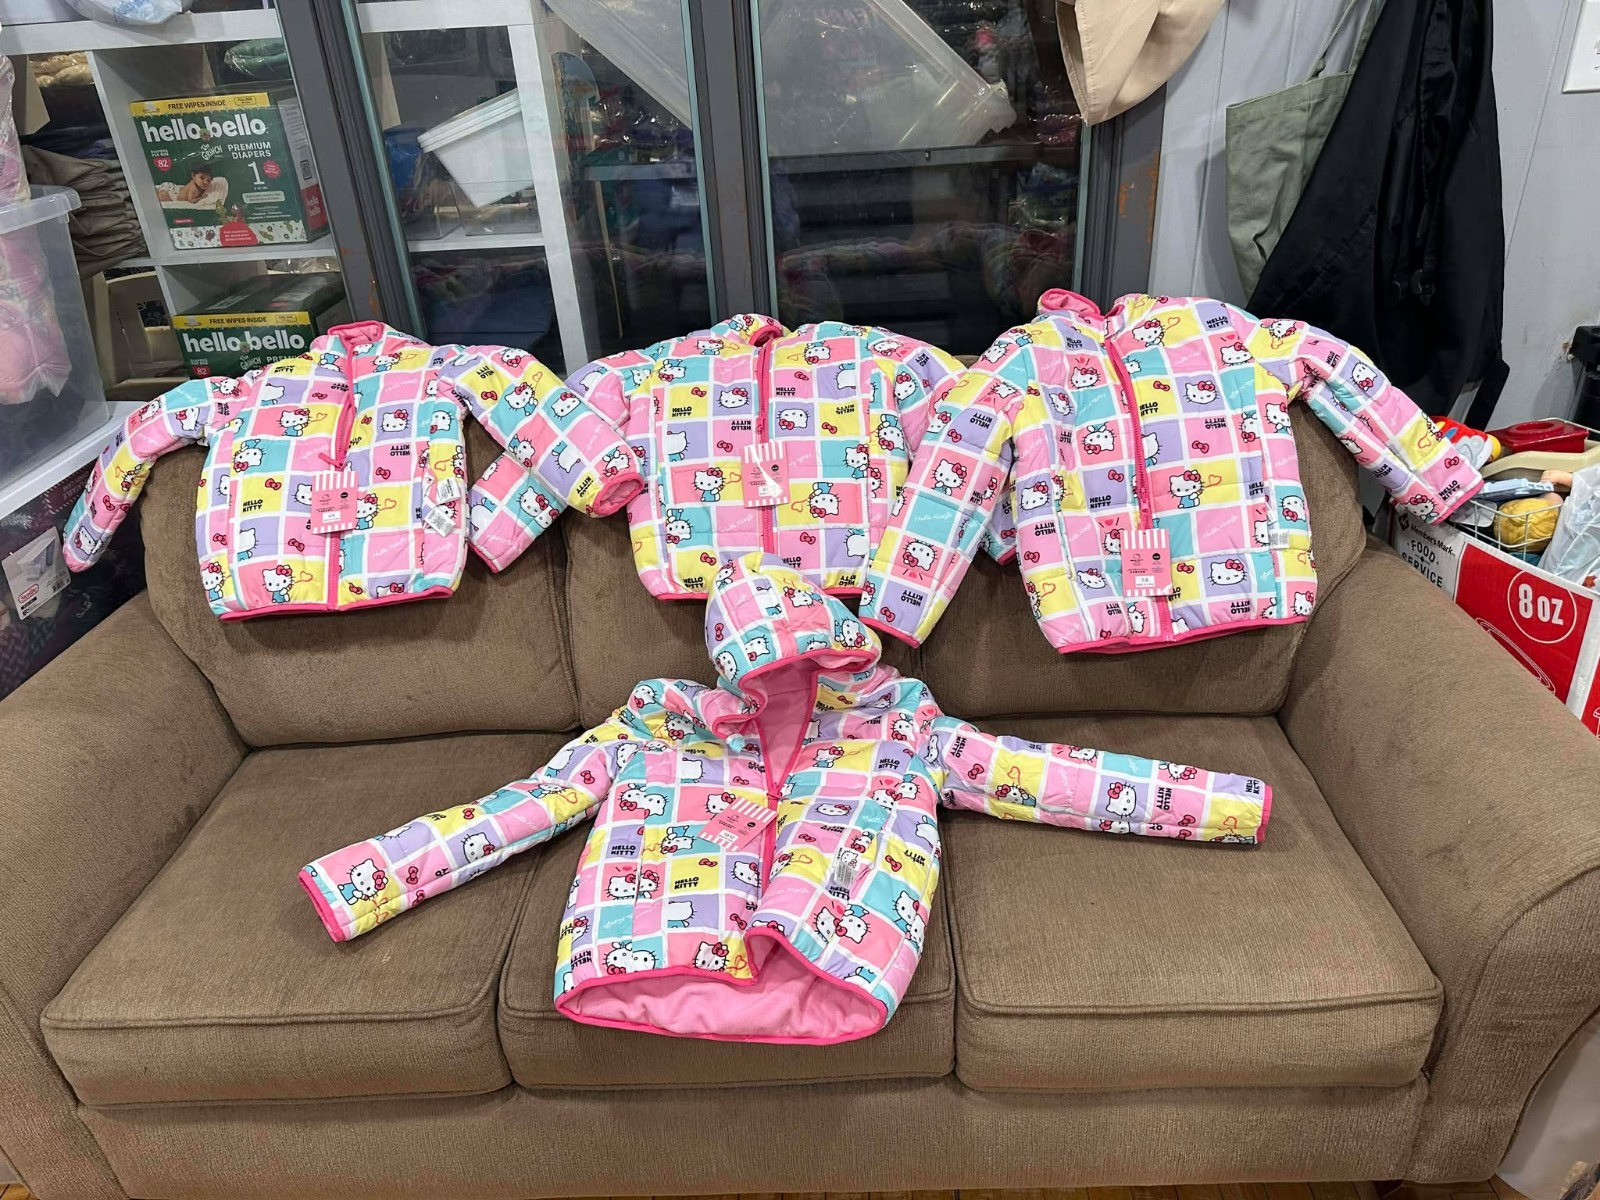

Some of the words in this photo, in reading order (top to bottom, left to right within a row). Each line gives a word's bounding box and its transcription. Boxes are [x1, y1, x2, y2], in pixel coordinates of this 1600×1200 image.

[141, 118, 200, 142] hello
[204, 114, 266, 138] bello
[228, 142, 272, 152] PREMIUM
[232, 150, 272, 160] DIAPERS
[157, 160, 168, 168] 82
[248, 161, 266, 185] 1
[1207, 316, 1228, 324] HELLO
[1208, 320, 1228, 328] KITTY
[182, 332, 240, 352] hello
[244, 330, 305, 350] bello
[974, 412, 992, 423] KITTY
[970, 418, 990, 429] HELLO
[1439, 480, 1458, 496] HELLO
[1442, 484, 1460, 501] KITTY
[242, 504, 262, 513] KITTY
[243, 499, 264, 507] HELLO
[1035, 528, 1056, 536] HELLO
[1411, 524, 1436, 545] Member's
[1437, 540, 1453, 555] Mark
[1411, 540, 1436, 563] FOOD
[901, 596, 922, 606] HELLO
[902, 590, 924, 601] KITTY
[1518, 584, 1533, 618] 8
[950, 736, 962, 757] KITTY
[956, 737, 966, 758] HELLO
[1156, 787, 1164, 810] KITTY
[1163, 788, 1172, 811] HELLO
[675, 876, 699, 884] HELLO
[674, 882, 698, 890] KITTY
